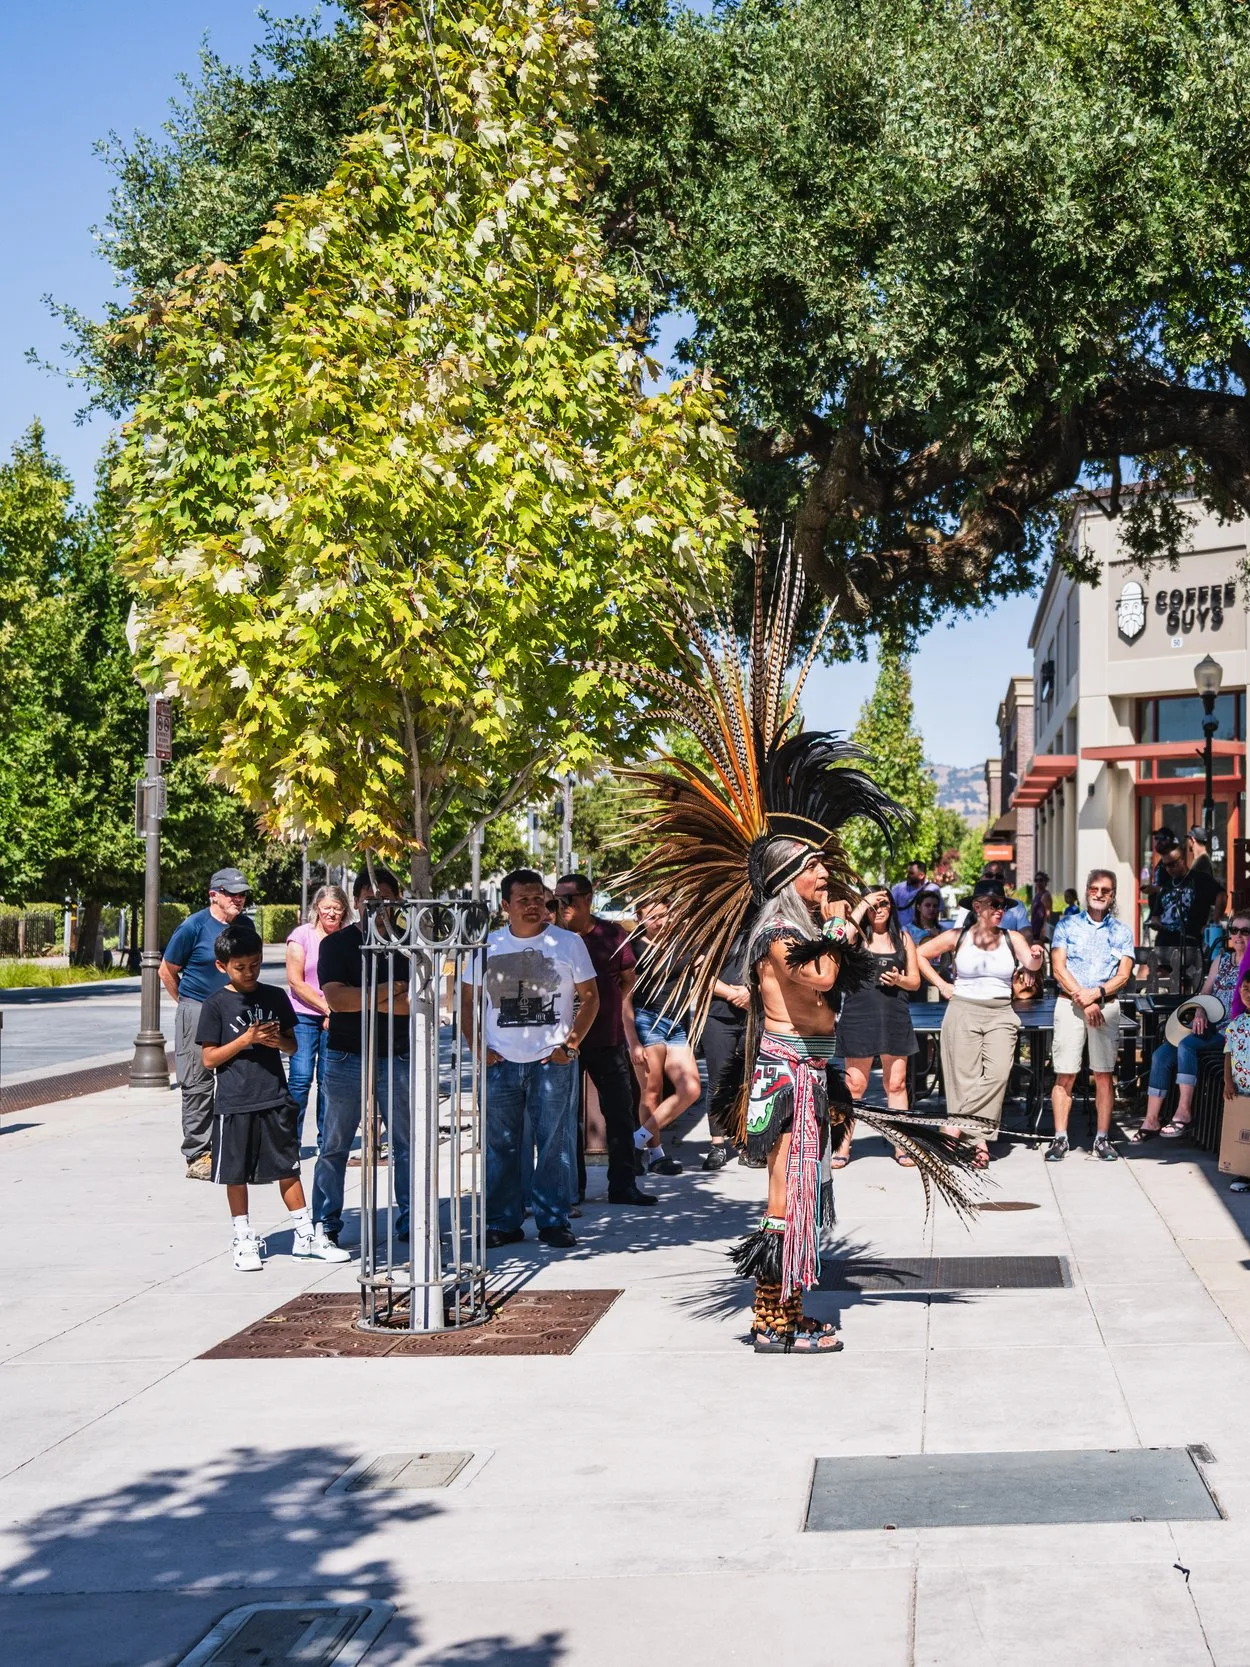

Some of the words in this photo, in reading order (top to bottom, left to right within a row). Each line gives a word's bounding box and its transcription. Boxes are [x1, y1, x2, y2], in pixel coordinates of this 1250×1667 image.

[1156, 583, 1236, 611] COFFEE
[1167, 606, 1223, 630] GUYS
[229, 1008, 278, 1033] JORDA
